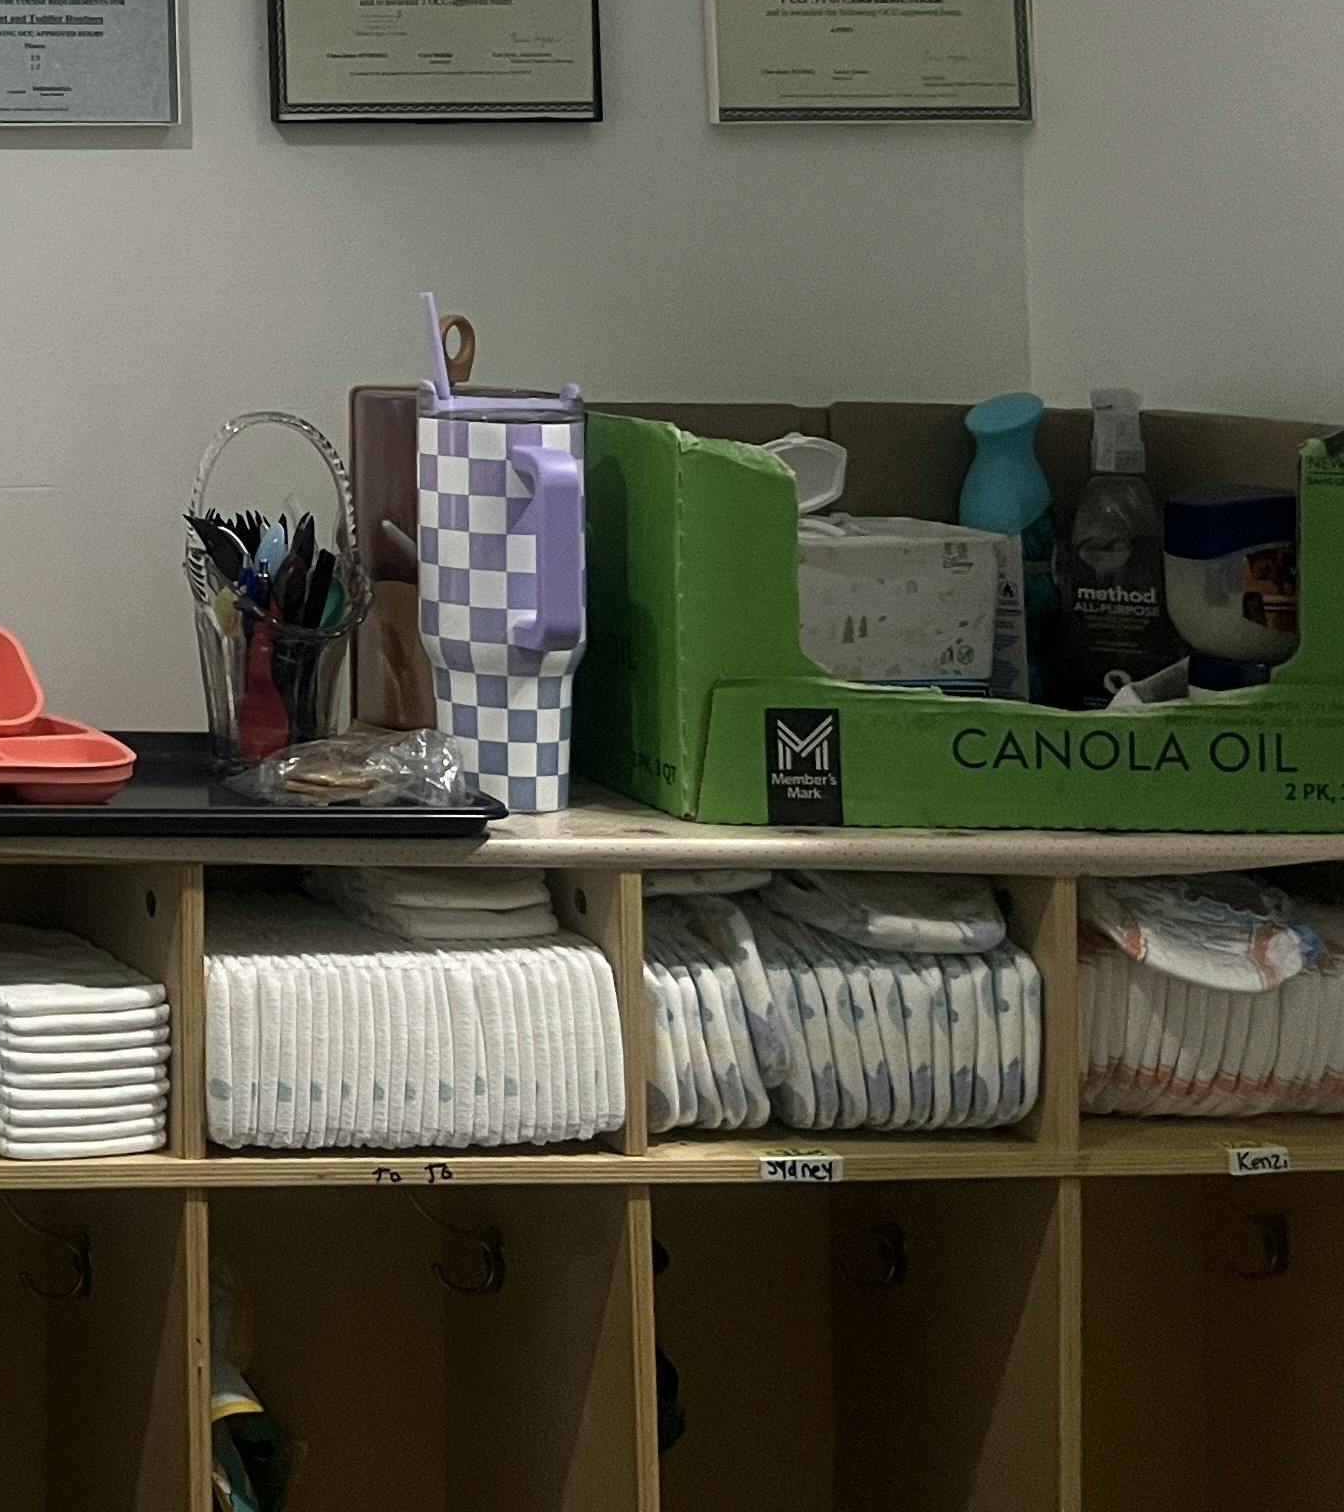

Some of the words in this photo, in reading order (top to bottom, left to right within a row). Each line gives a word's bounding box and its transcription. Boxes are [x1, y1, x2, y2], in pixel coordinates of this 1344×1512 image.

[1078, 586, 1156, 603] method
[953, 729, 1189, 773] CANOLA
[1210, 731, 1298, 773] OIL
[771, 773, 836, 785] Member's
[788, 787, 821, 799] Mark
[1285, 784, 1296, 800] 2
